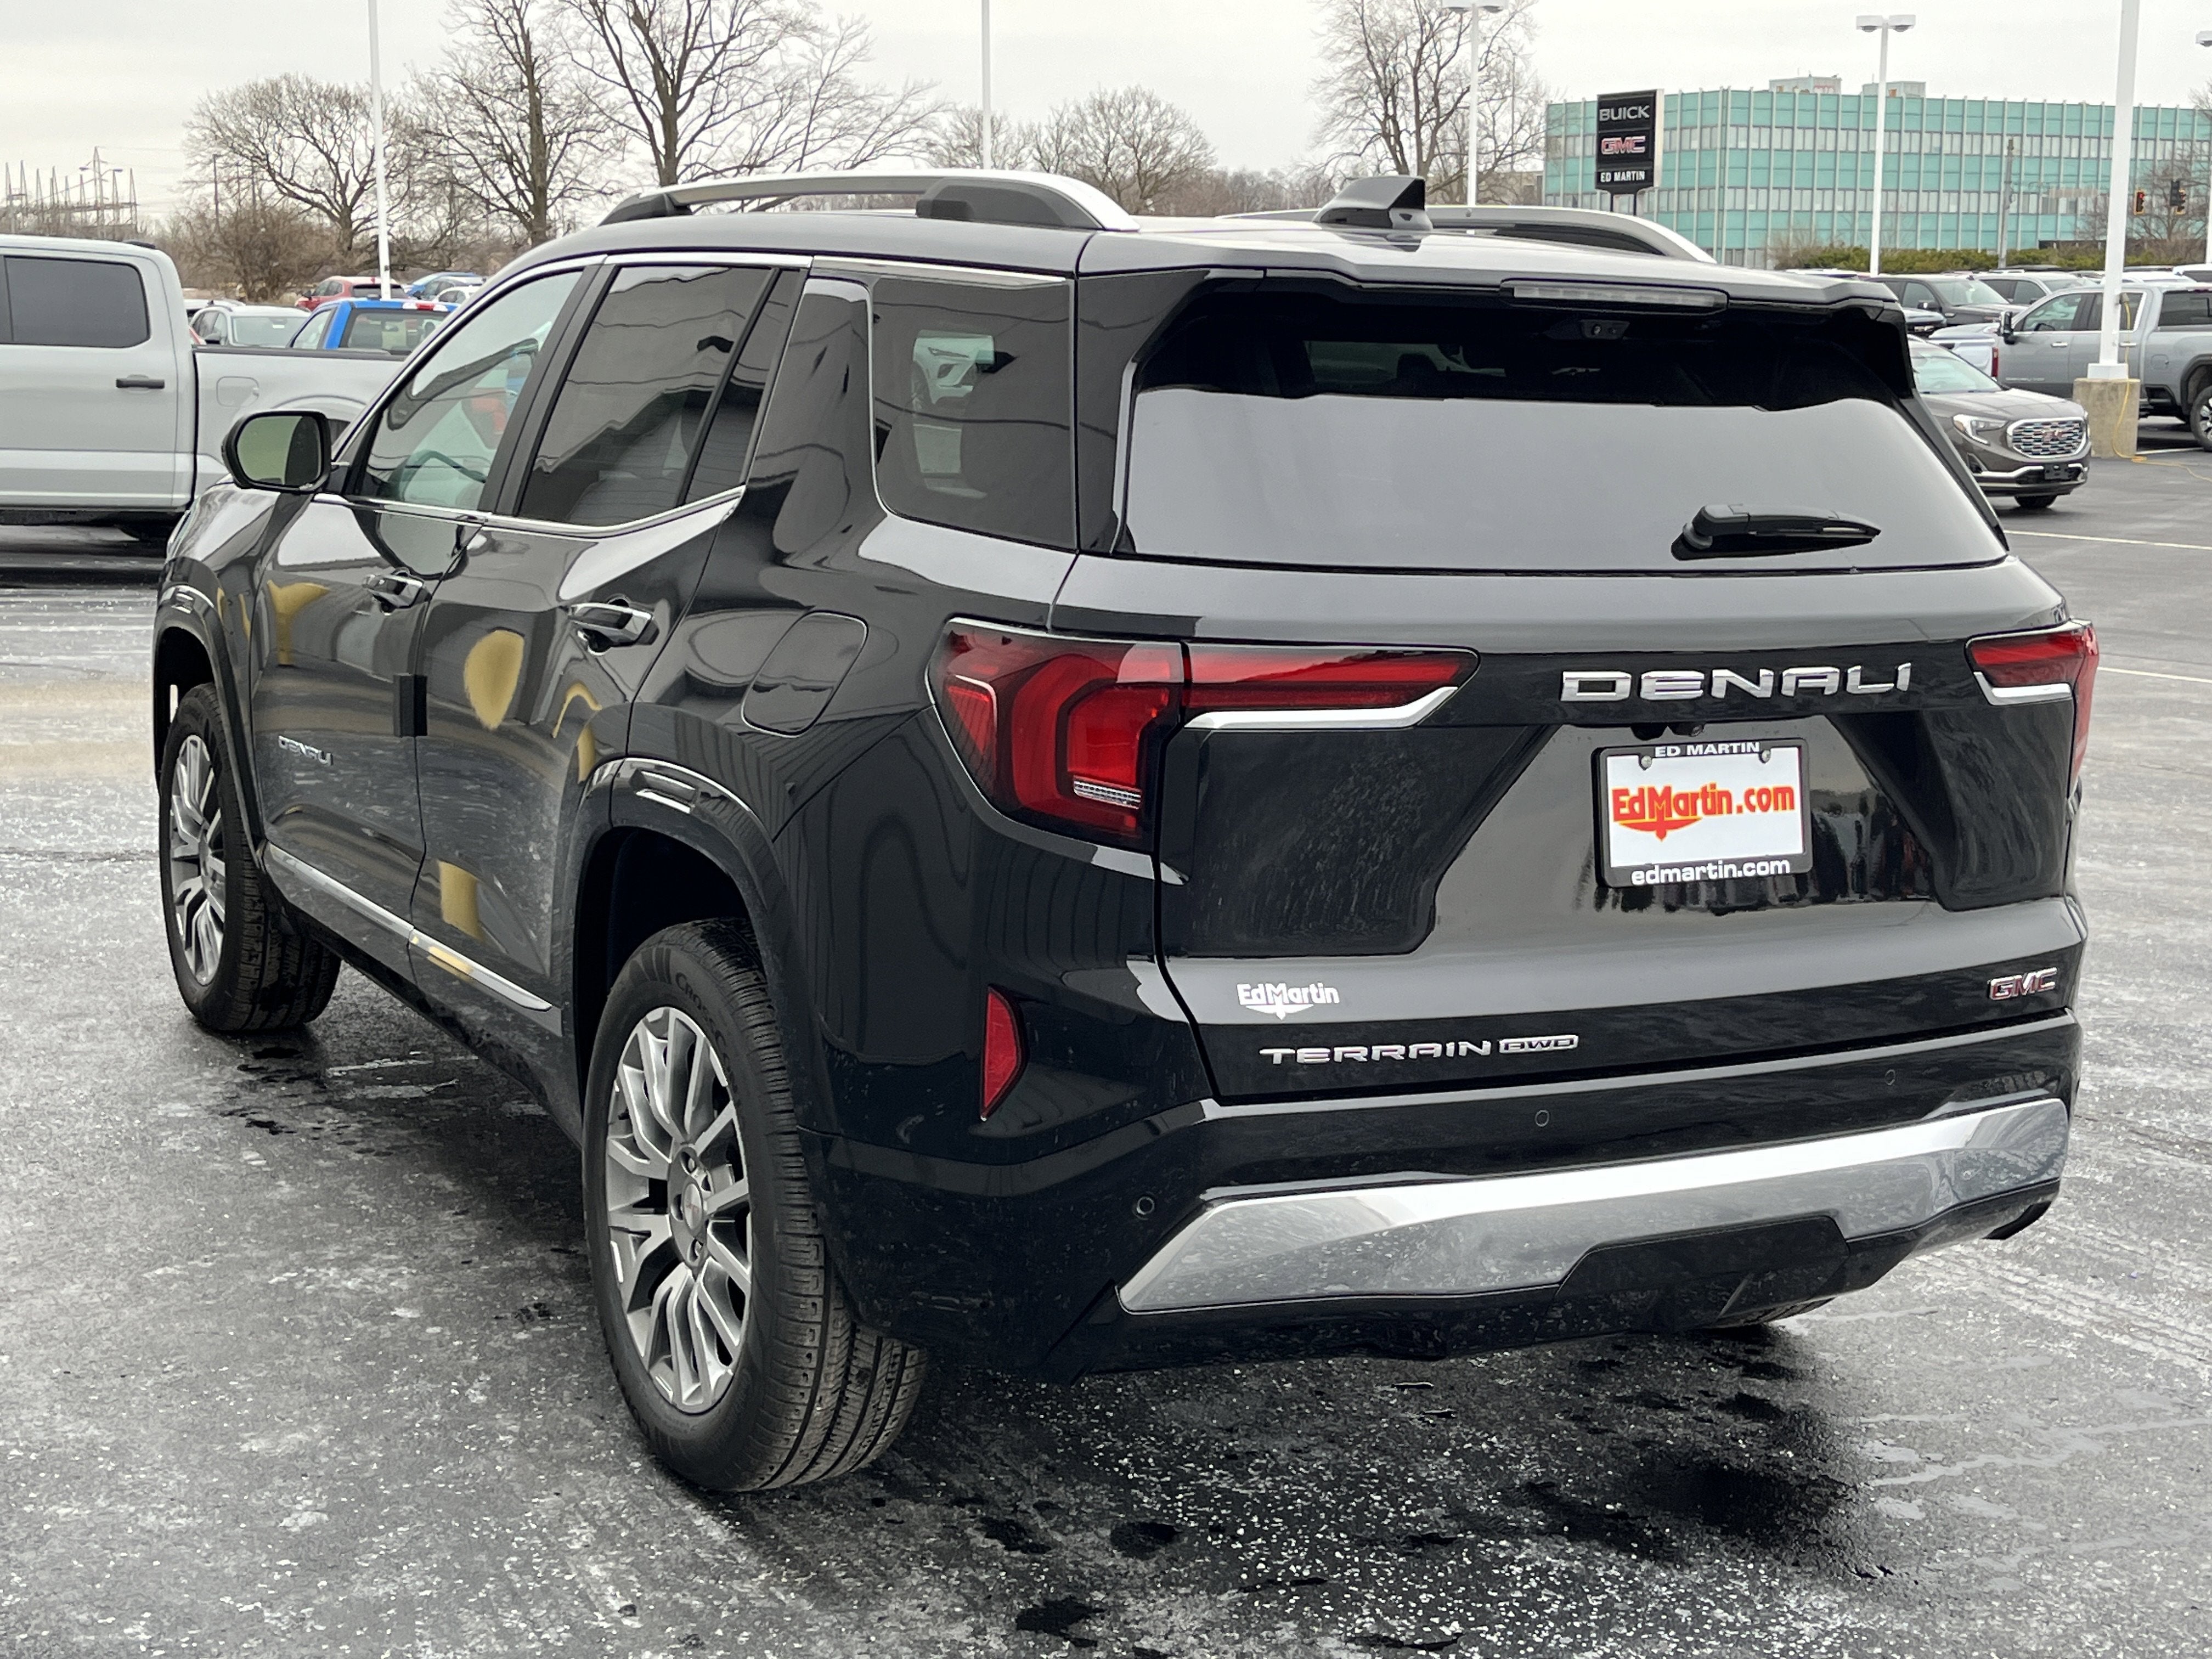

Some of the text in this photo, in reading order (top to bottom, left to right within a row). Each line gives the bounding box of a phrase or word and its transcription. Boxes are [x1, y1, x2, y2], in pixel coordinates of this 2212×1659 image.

[1599, 105, 1650, 121] BUICK
[1601, 136, 1646, 155] GMC
[1600, 171, 1645, 183] ED MARTIN
[1561, 663, 1911, 701] DENALI
[1655, 742, 1760, 757] ED MARTIN
[1631, 858, 1790, 885] edmartin.com
[1990, 967, 2057, 1001] GMC
[1260, 1037, 1576, 1065] TERRAIN AWD
